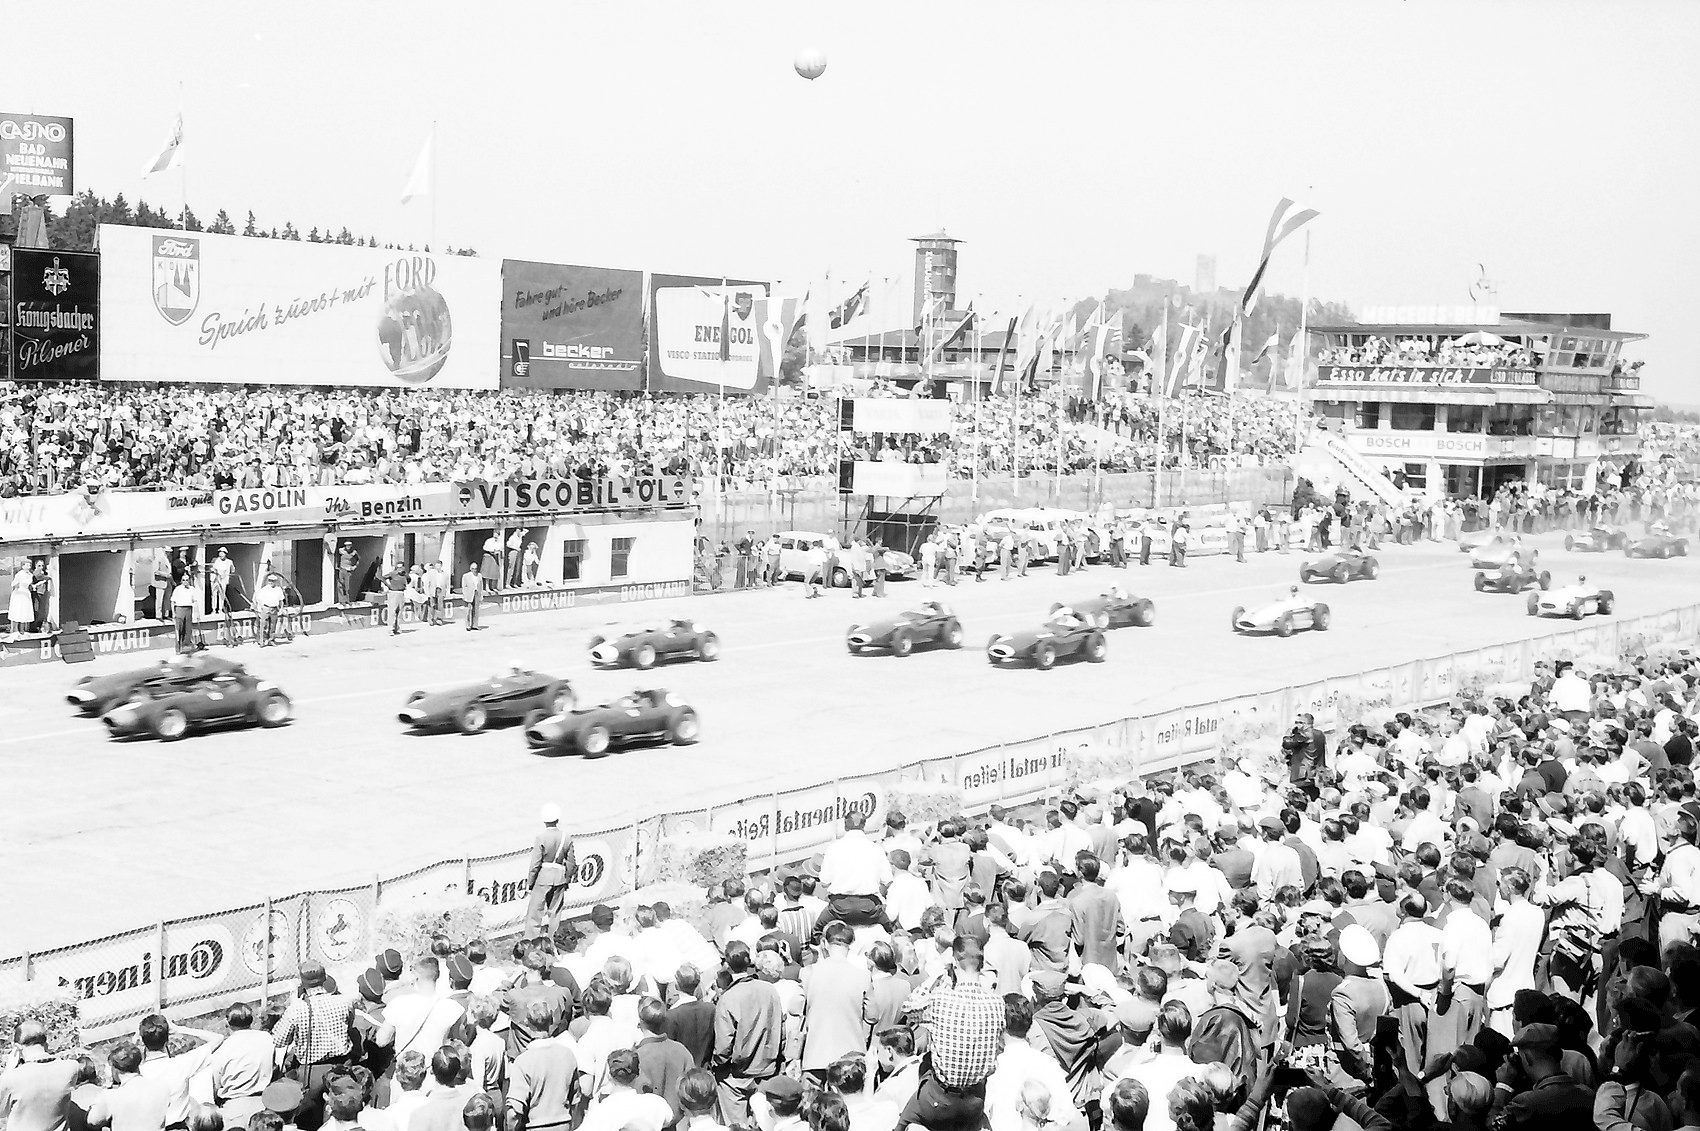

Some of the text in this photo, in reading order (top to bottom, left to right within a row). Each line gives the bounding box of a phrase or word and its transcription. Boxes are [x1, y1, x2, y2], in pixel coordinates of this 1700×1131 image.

[0, 120, 65, 142] CASINO
[20, 143, 45, 155] BAD
[6, 154, 67, 169] NEUENAHR
[158, 239, 194, 257] Ford
[384, 257, 437, 303] FORD
[16, 301, 94, 332] Königsbacher
[198, 302, 268, 350] Sprich
[342, 276, 377, 304] mit
[694, 325, 754, 345] ENEGOL
[17, 332, 90, 370] Pilsener
[543, 341, 614, 358] becker
[667, 350, 690, 360] VISCO
[1330, 367, 1365, 382] Esso
[1409, 368, 1425, 383] in
[1366, 438, 1482, 451] BOSCH BOSCH
[219, 490, 306, 515] GASOLIN
[361, 496, 422, 517] Benzin
[503, 591, 575, 613] BORGWARD
[621, 580, 686, 602] BORGWARD
[40, 628, 150, 660] BWARD
